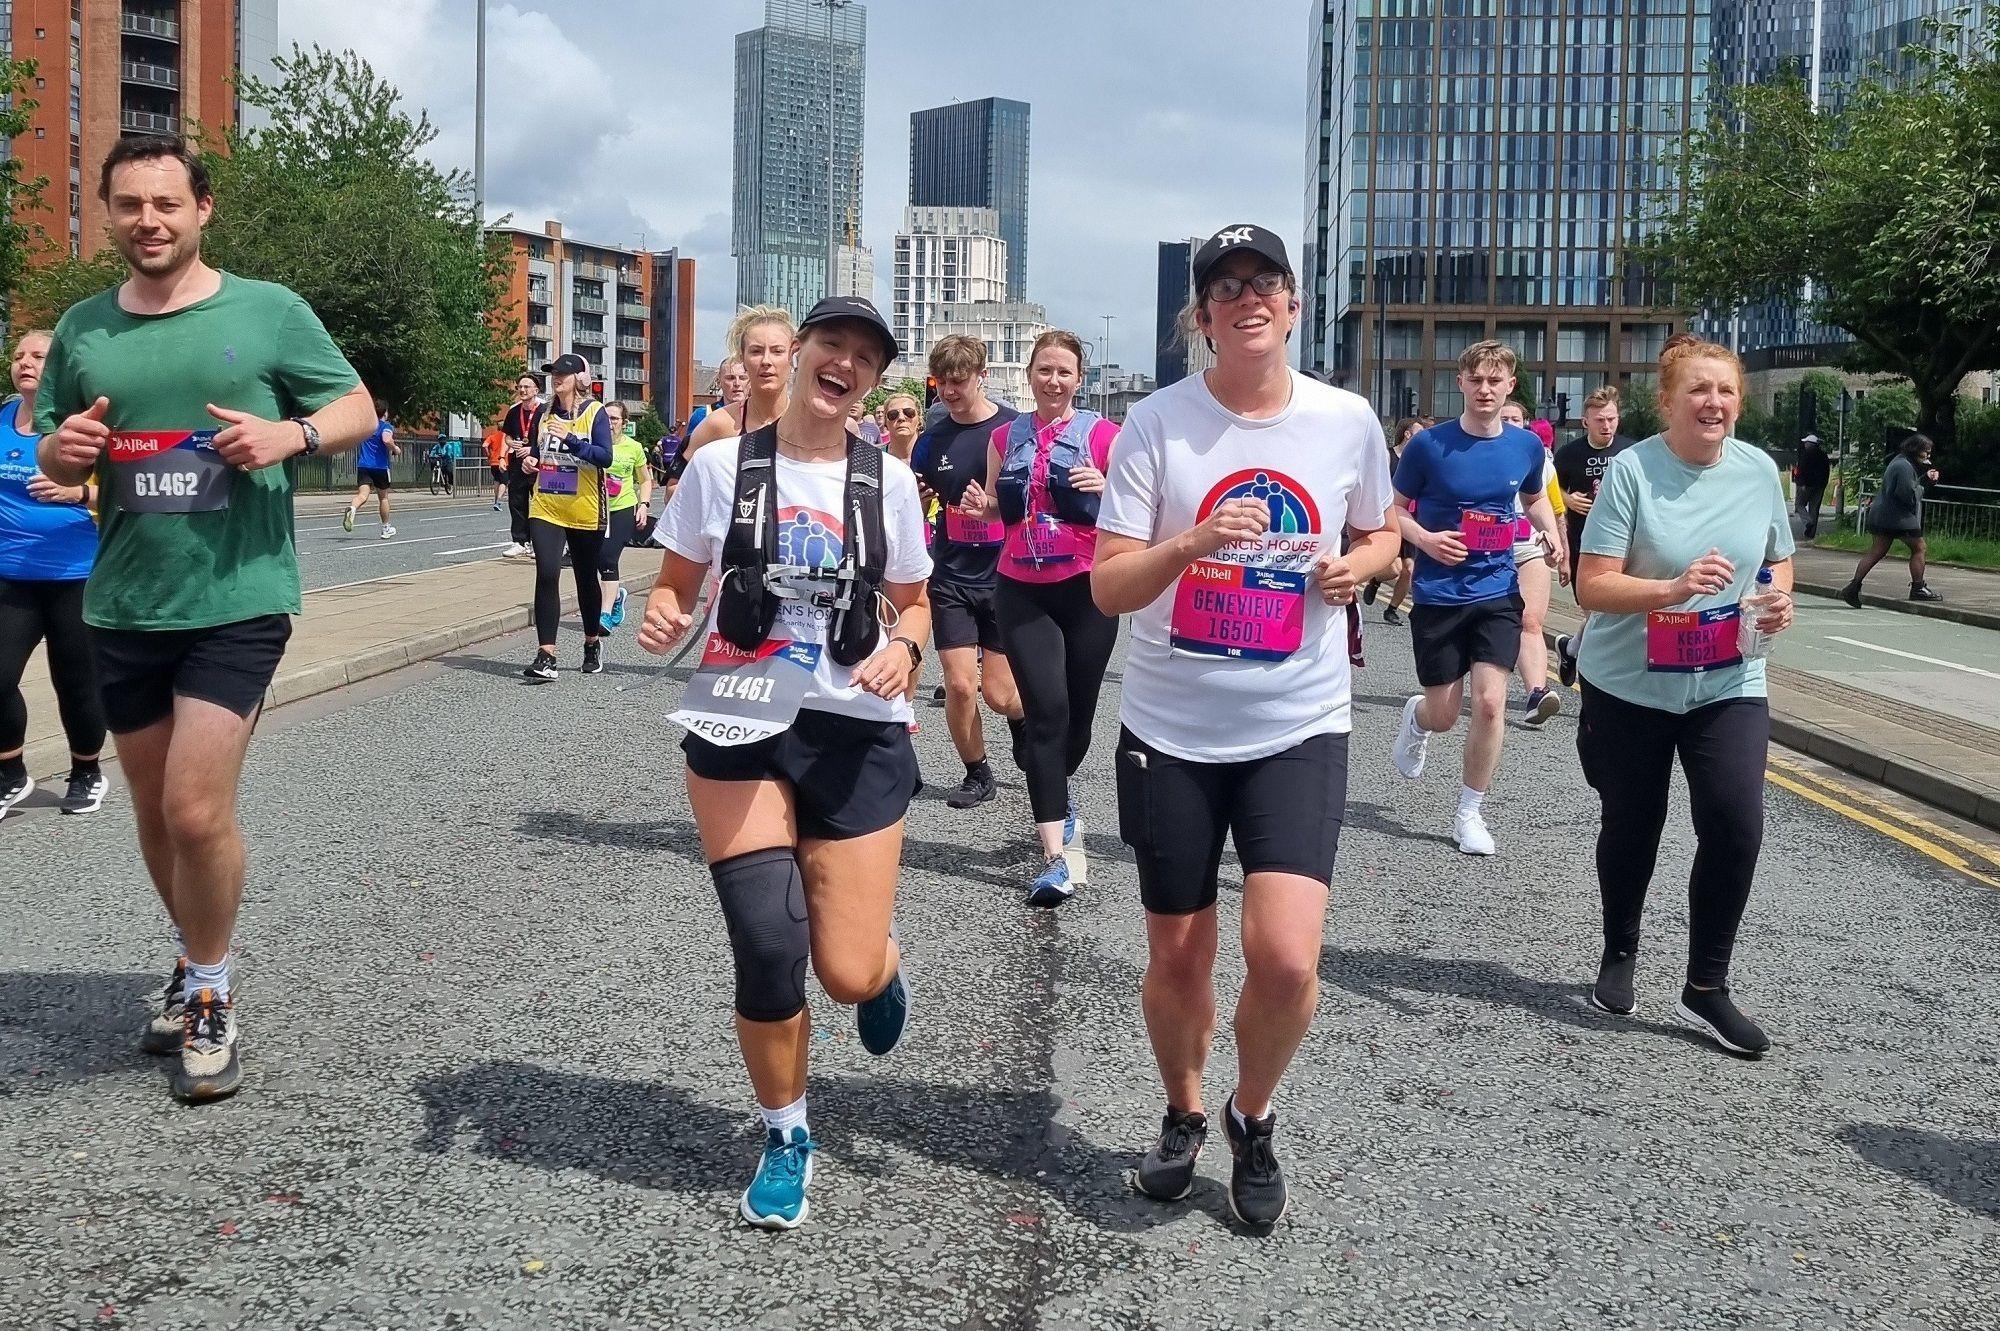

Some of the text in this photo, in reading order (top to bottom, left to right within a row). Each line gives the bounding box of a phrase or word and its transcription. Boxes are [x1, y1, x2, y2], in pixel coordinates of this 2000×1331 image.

[1218, 227, 1254, 248] NY
[122, 439, 159, 453] AJBell
[135, 472, 198, 496] 61462
[1267, 540, 1319, 552] HOUSE
[1267, 554, 1312, 563] HOSPICE
[1199, 567, 1232, 580] AJBell
[1194, 589, 1284, 620] GENEVIEVE
[1665, 616, 1690, 625] AJBell
[1207, 617, 1263, 644] 16501
[1677, 628, 1718, 646] KERRY
[1227, 648, 1242, 656] 10K
[712, 675, 775, 703] 61461
